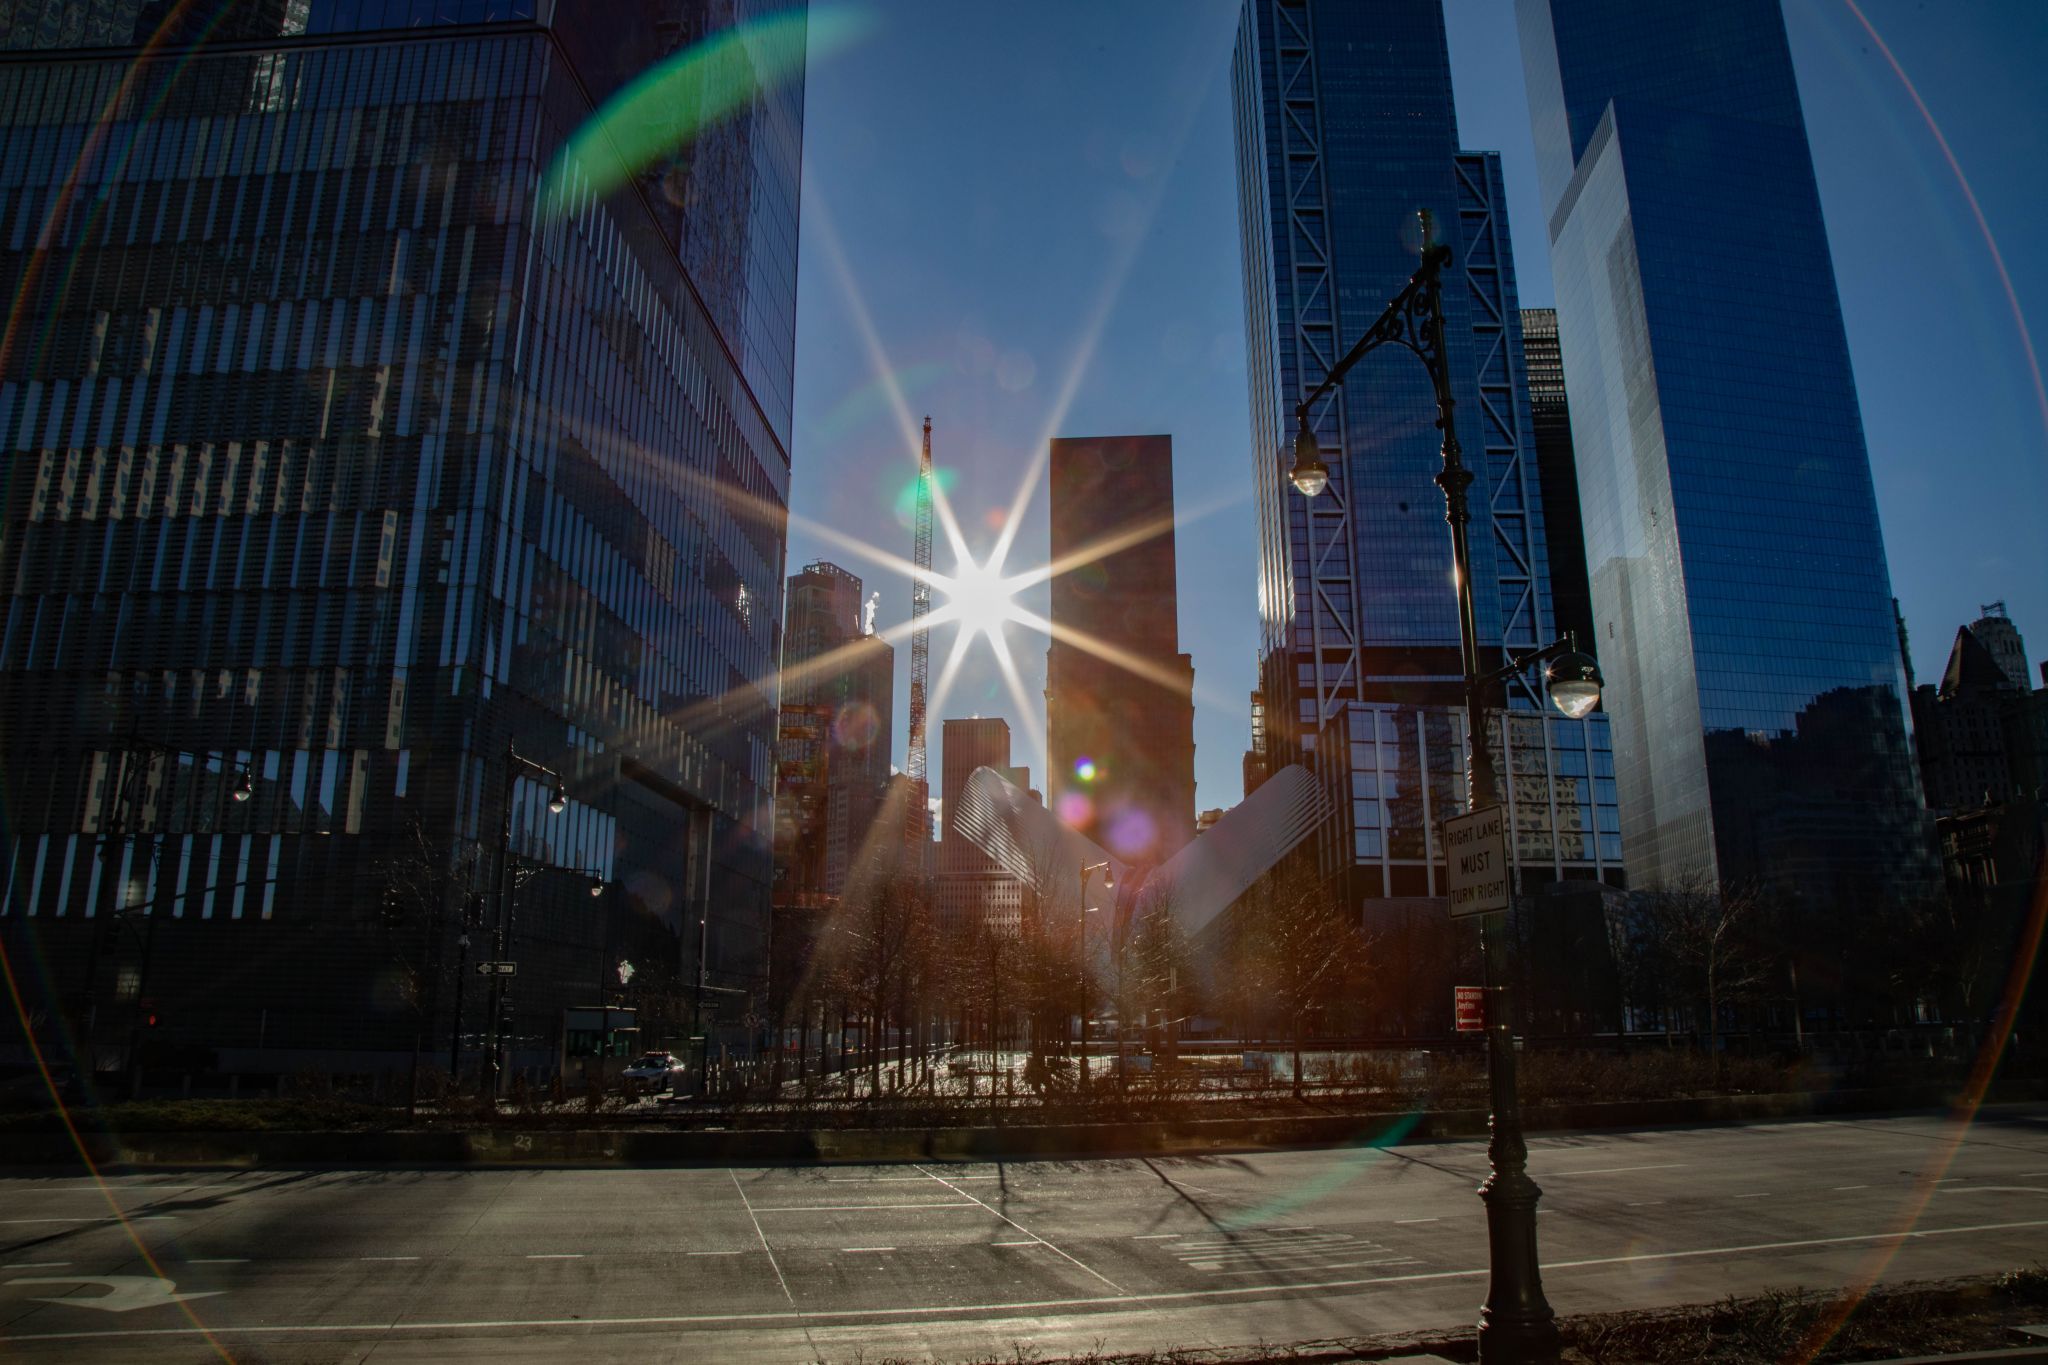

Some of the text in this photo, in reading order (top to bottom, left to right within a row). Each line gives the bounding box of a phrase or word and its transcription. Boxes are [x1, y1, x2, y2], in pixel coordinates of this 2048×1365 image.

[1448, 819, 1501, 847] RIGHT LANE
[1460, 851, 1490, 875] MUST
[1451, 880, 1505, 905] TURN RIGHT
